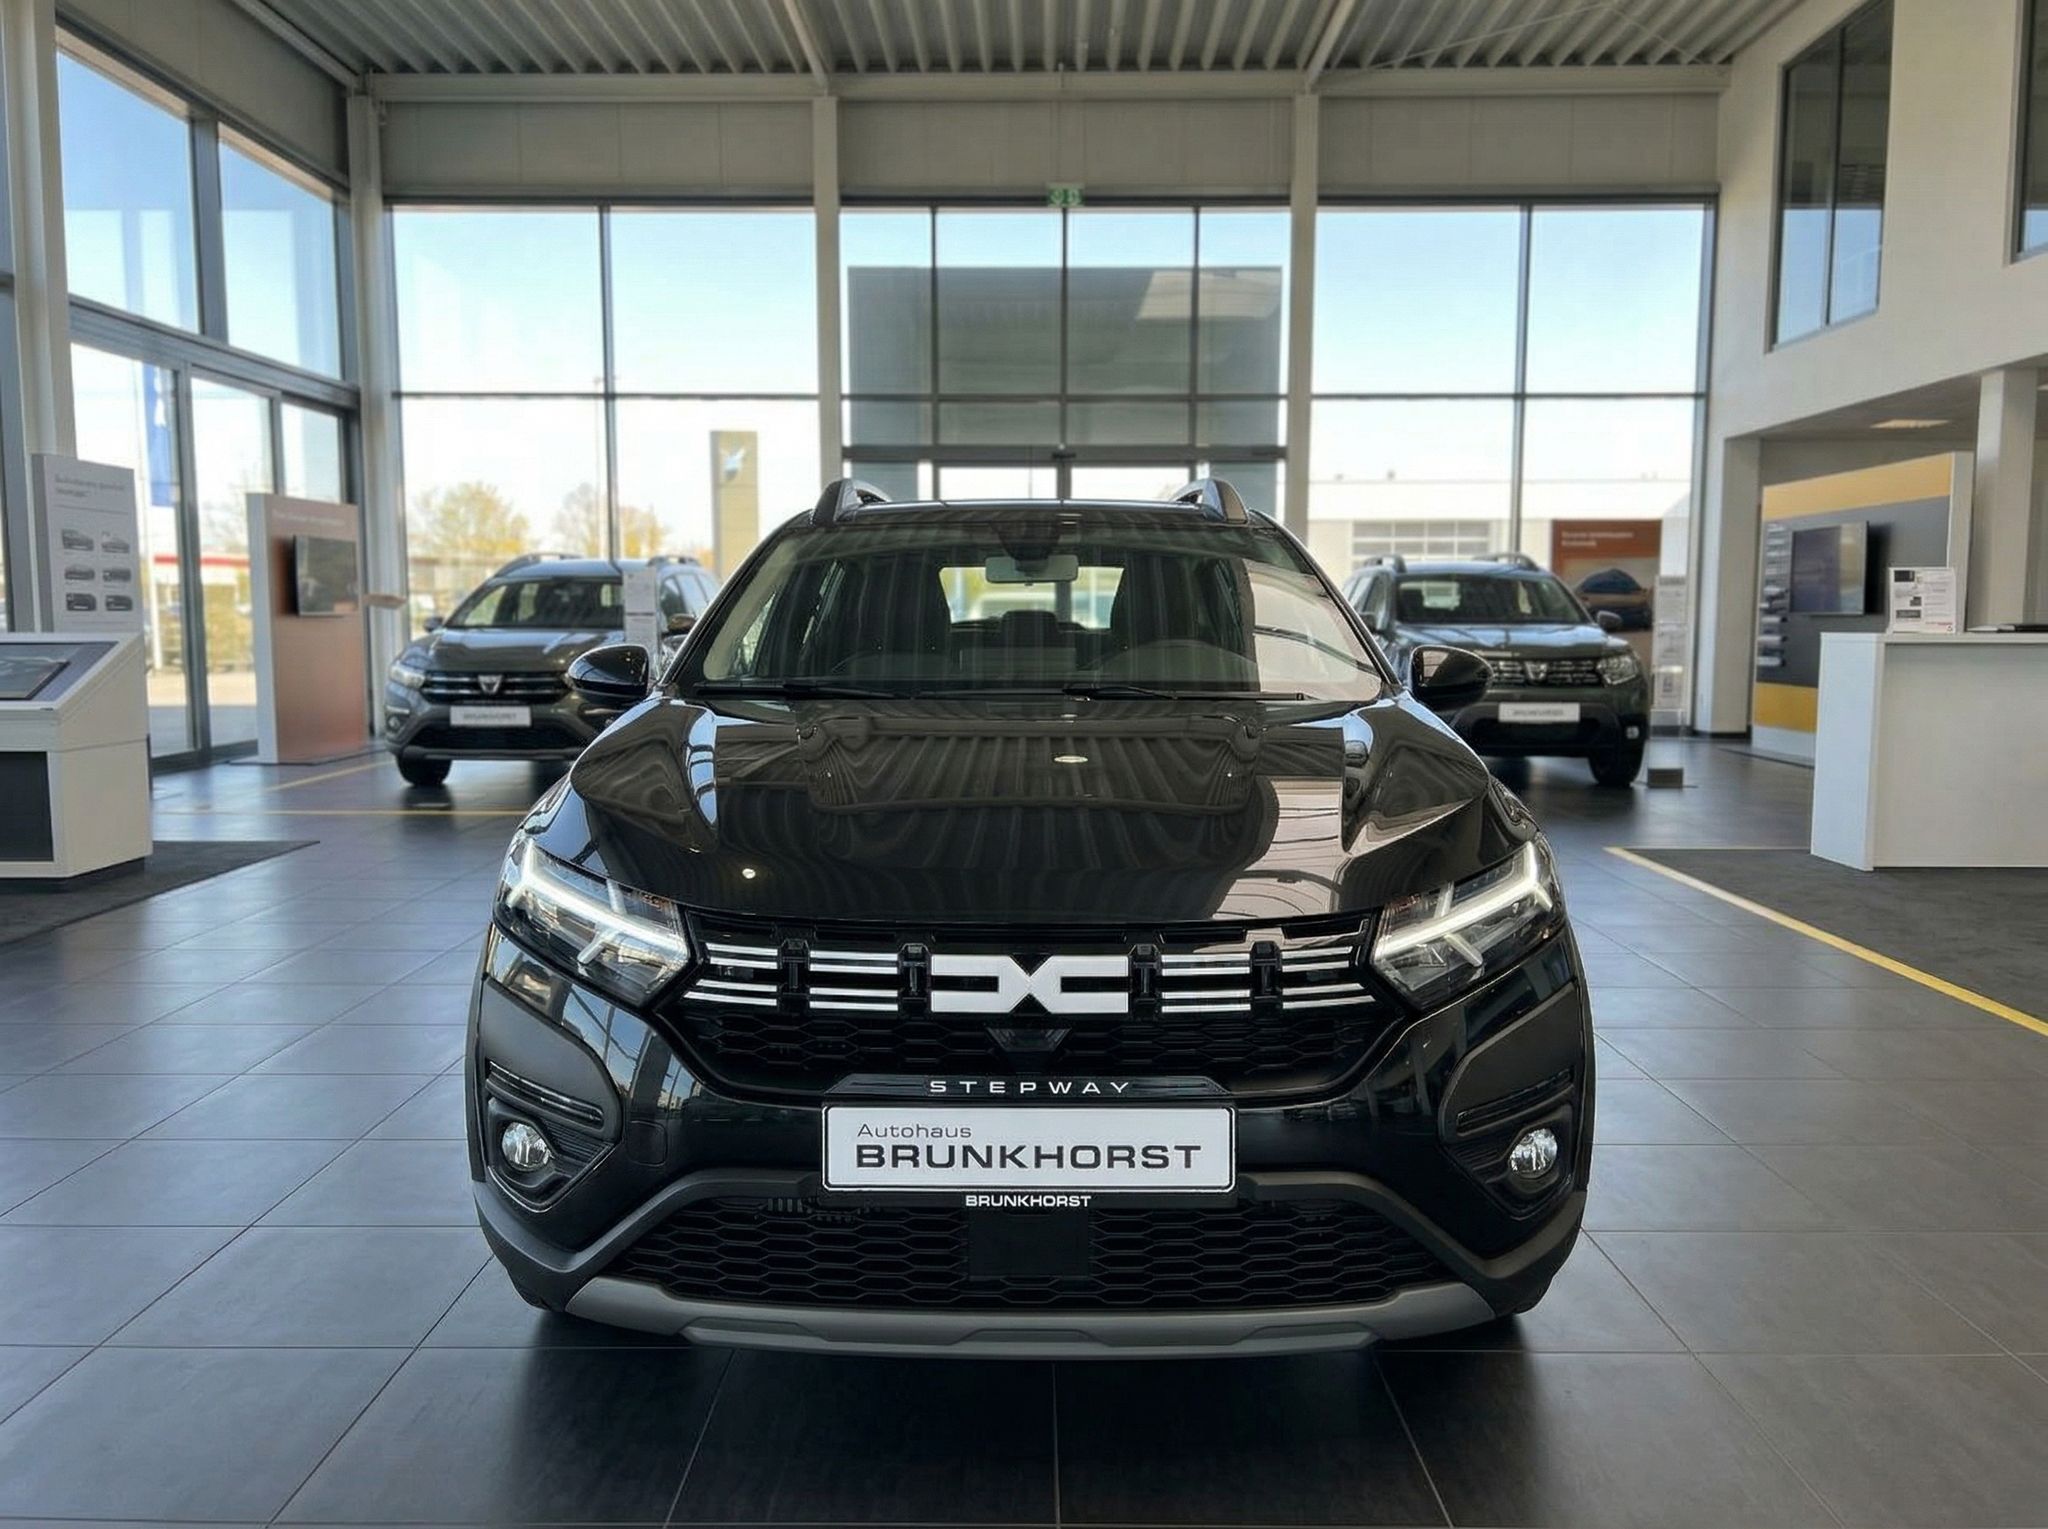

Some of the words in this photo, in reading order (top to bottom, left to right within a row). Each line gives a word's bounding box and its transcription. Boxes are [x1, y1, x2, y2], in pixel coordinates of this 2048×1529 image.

[929, 1080, 1129, 1097] STEPWAY
[857, 1123, 972, 1138] Autohaus
[856, 1144, 1202, 1169] BRUNKHORST
[965, 1194, 1092, 1208] BRUNKHORST
